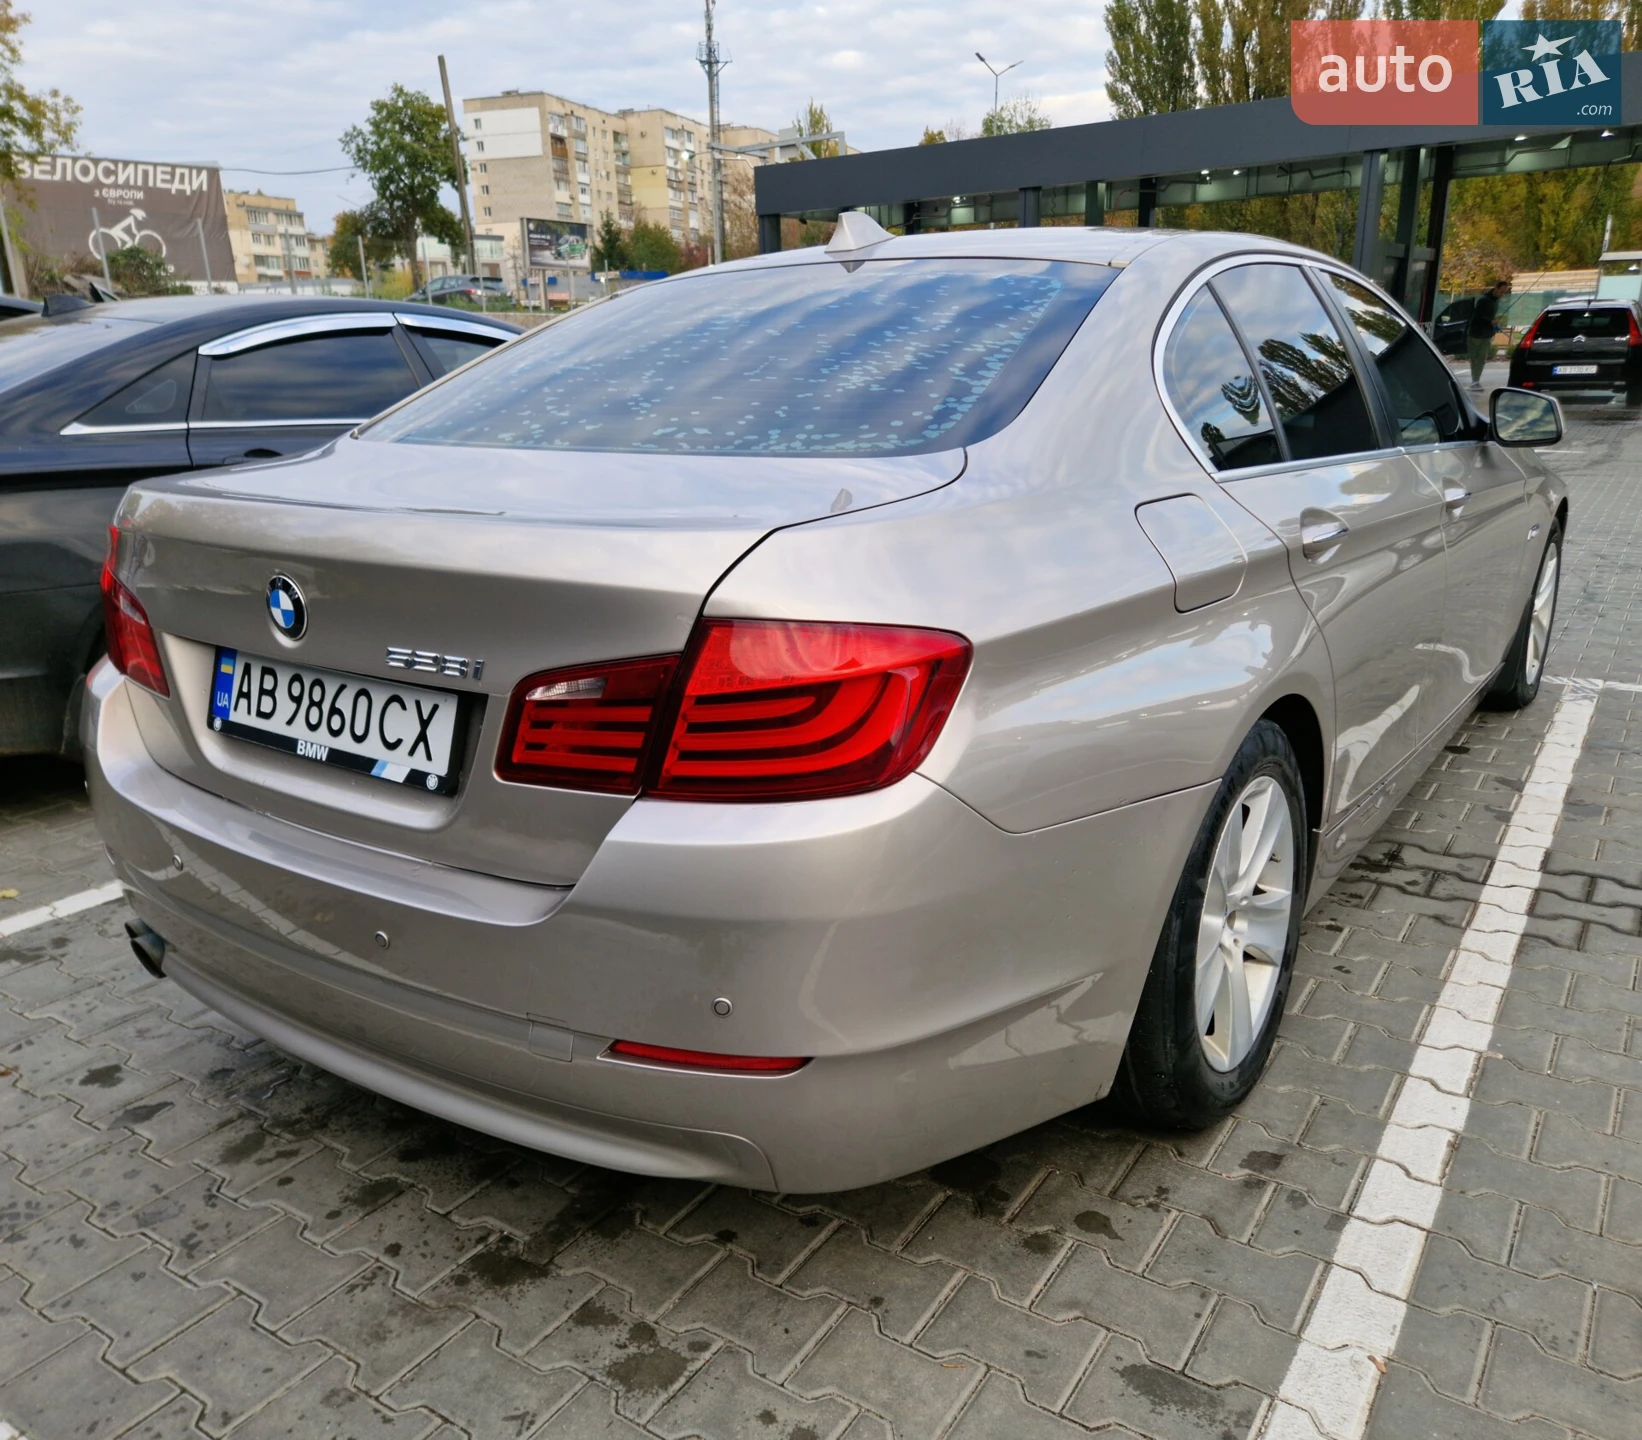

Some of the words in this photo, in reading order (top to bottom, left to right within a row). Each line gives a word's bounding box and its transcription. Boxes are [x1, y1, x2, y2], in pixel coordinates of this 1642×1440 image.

[102, 187, 144, 200] ЄВРОПИ
[385, 646, 485, 681] 528i
[216, 690, 229, 709] UA
[296, 739, 330, 762] BMW
